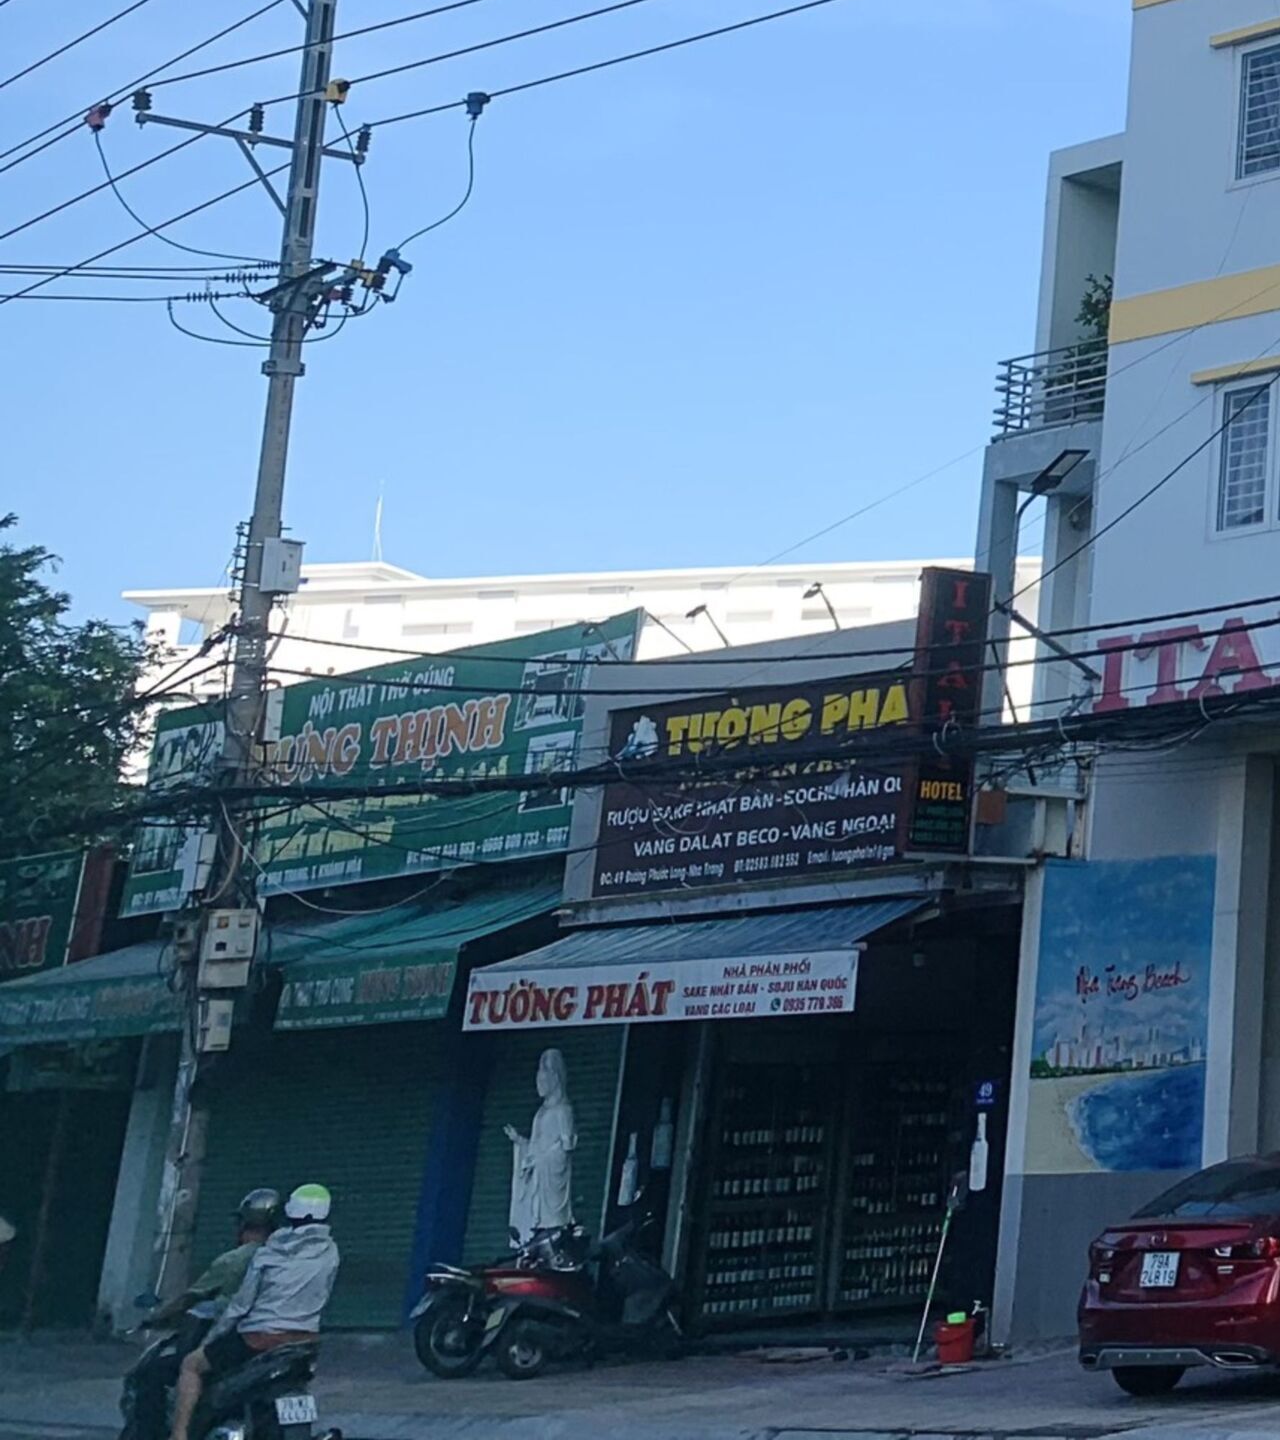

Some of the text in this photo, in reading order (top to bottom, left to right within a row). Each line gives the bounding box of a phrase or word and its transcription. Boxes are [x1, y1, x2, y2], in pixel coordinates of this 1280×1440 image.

[412, 665, 456, 696] CÚNG
[369, 693, 512, 772] THỊNH
[665, 678, 910, 757] TƯỜNG PHÁ
[607, 807, 650, 830] RƯỢU
[843, 775, 880, 799] HÀN
[920, 780, 964, 801] HOTEL
[633, 840, 676, 858] VANG
[680, 831, 734, 852] DALAT
[842, 813, 896, 835] NGOẠI
[750, 960, 780, 976] PHÂN
[783, 956, 812, 974] PHỐI
[469, 977, 577, 1025] TƯỜNG
[583, 970, 677, 1019] PHÁT
[683, 984, 708, 999] SAKE
[767, 979, 795, 994] SOJU
[684, 1002, 709, 1017] VANG
[978, 1082, 993, 1097] 49
